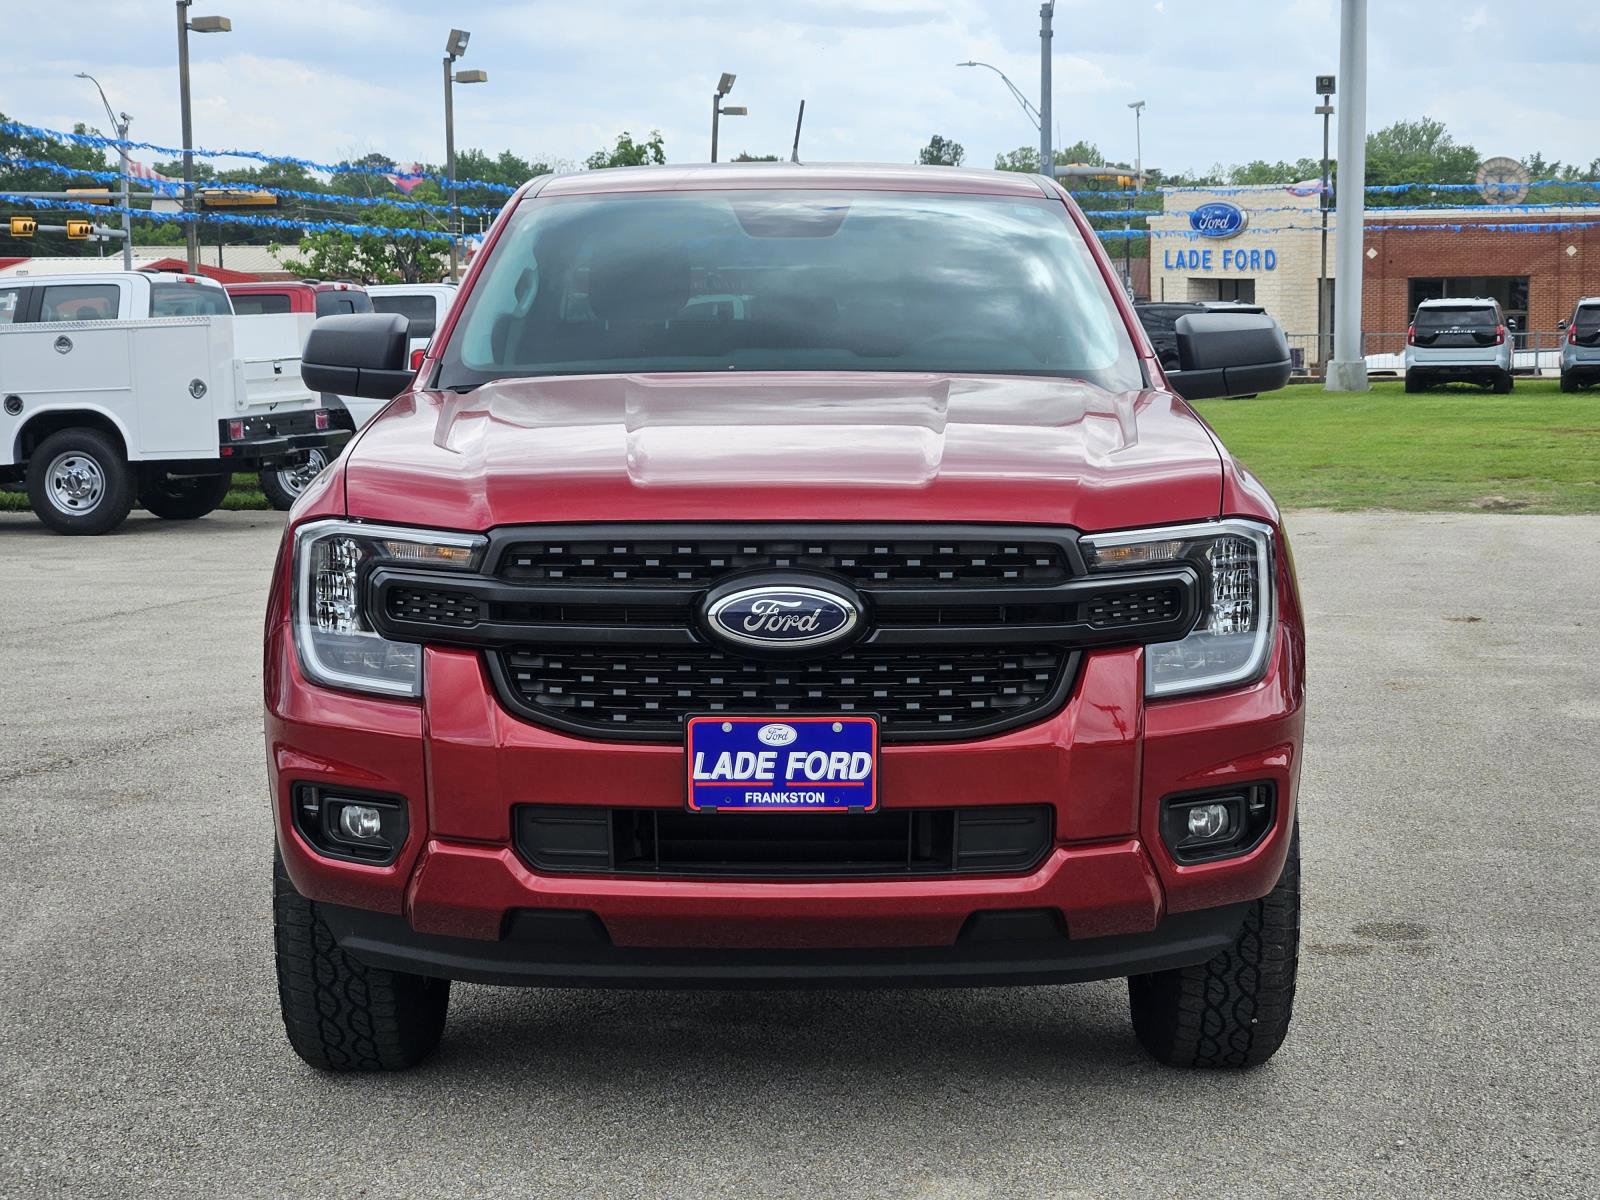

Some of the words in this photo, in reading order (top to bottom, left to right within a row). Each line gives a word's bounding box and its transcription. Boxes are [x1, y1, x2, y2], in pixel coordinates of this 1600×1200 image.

[1199, 208, 1230, 229] Ford
[1164, 249, 1213, 271] LADE
[1223, 249, 1277, 271] FORD
[743, 599, 822, 632] Ford
[765, 727, 789, 741] Ford
[692, 751, 778, 780] LADE
[785, 751, 872, 781] FORD
[745, 792, 825, 803] FRANKSTON
